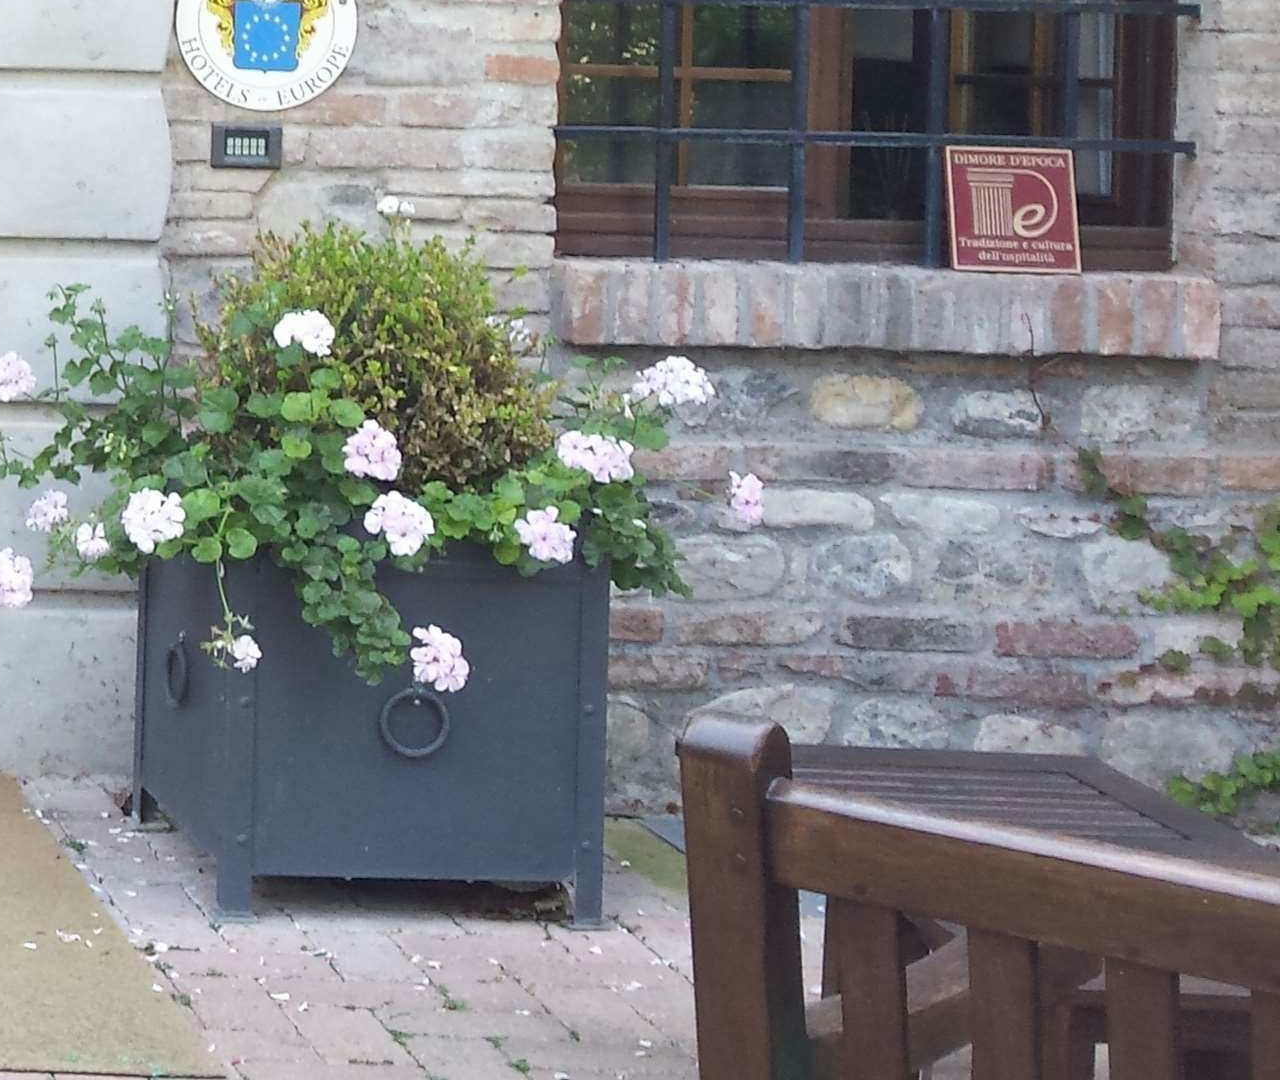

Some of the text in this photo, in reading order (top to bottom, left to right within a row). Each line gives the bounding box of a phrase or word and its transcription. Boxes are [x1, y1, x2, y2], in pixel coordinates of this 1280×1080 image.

[181, 37, 349, 106] HOTELS EUROPE
[953, 153, 1066, 169] DIMORE D'EPOCA
[958, 236, 1073, 252] Tradizione e cultura
[977, 250, 1056, 264] dell'ospitalità
